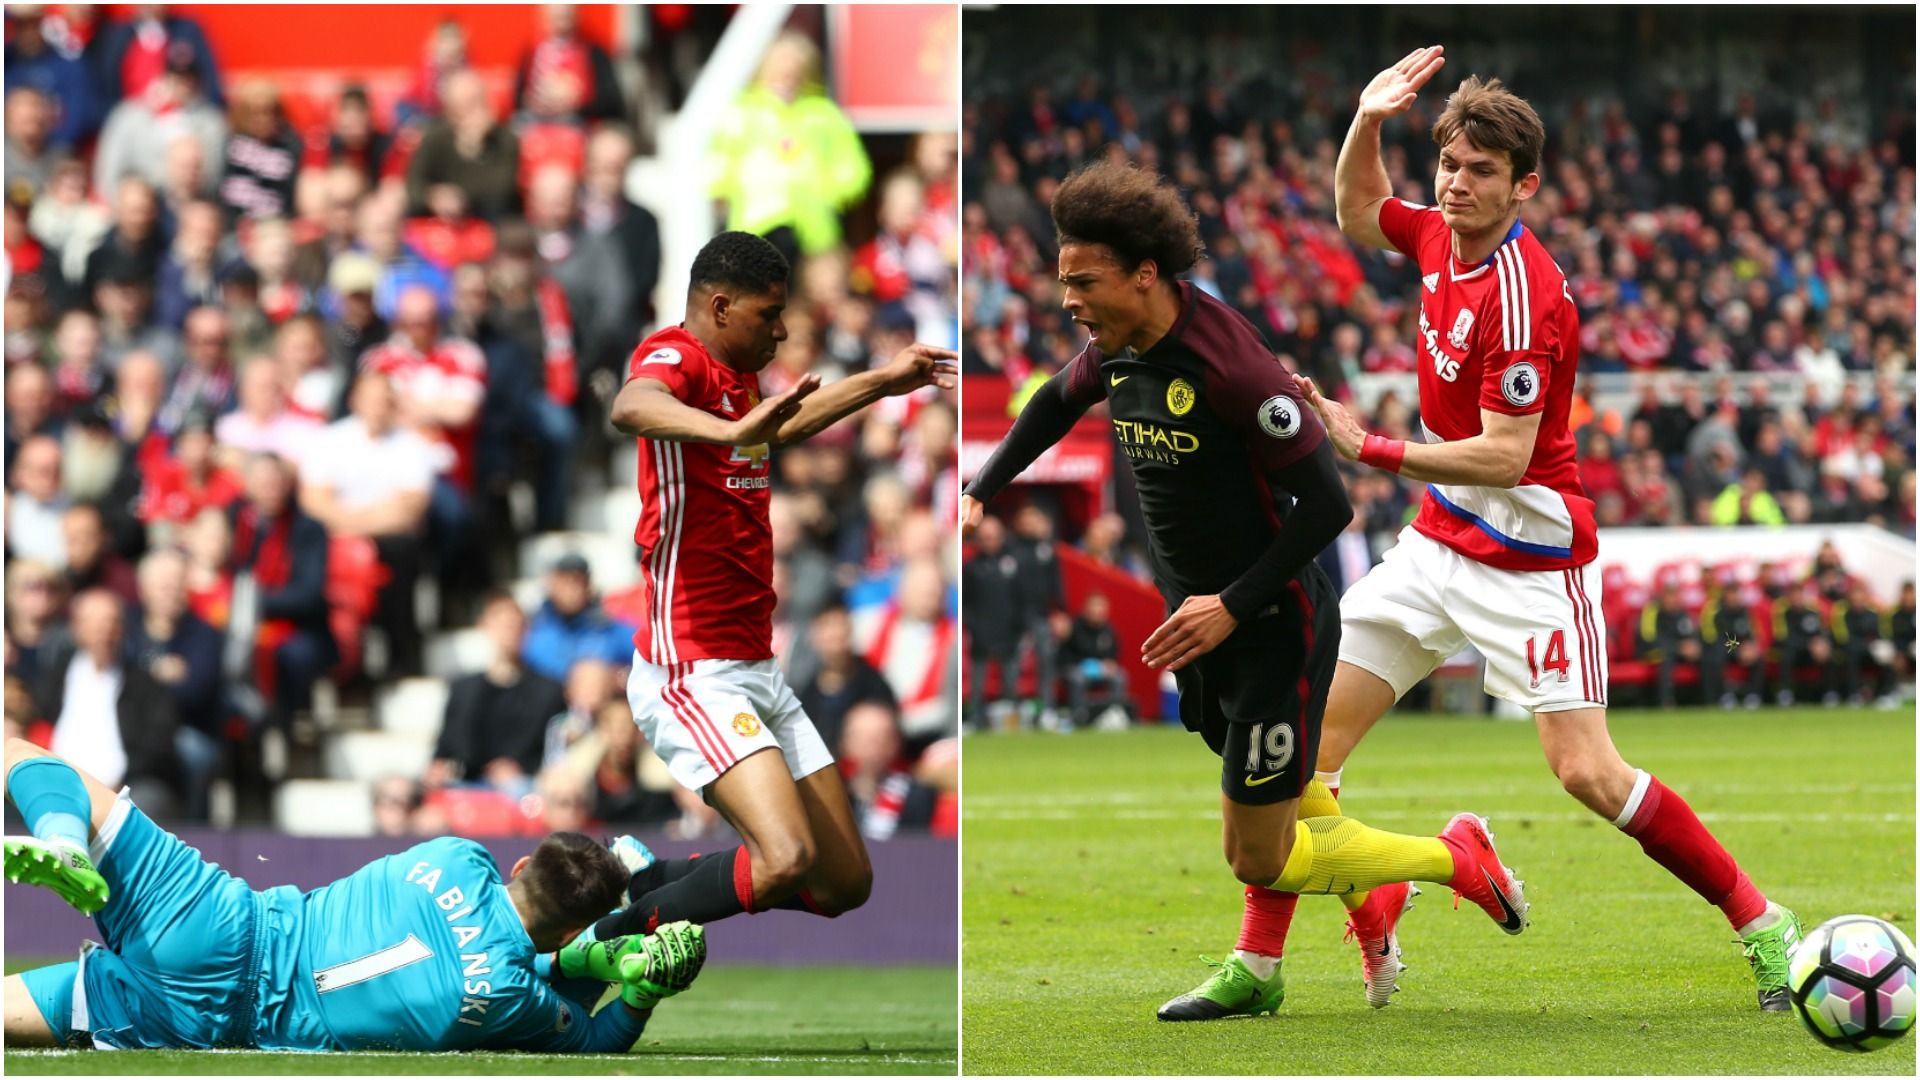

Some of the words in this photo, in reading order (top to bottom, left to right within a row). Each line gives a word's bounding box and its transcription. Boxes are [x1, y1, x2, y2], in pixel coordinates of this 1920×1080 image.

[1123, 445, 1179, 465] AIRWAYS
[1525, 628, 1572, 688] 14
[1245, 722, 1294, 772] 19
[313, 932, 435, 994] 1
[405, 861, 492, 1026] FABIANSKI
